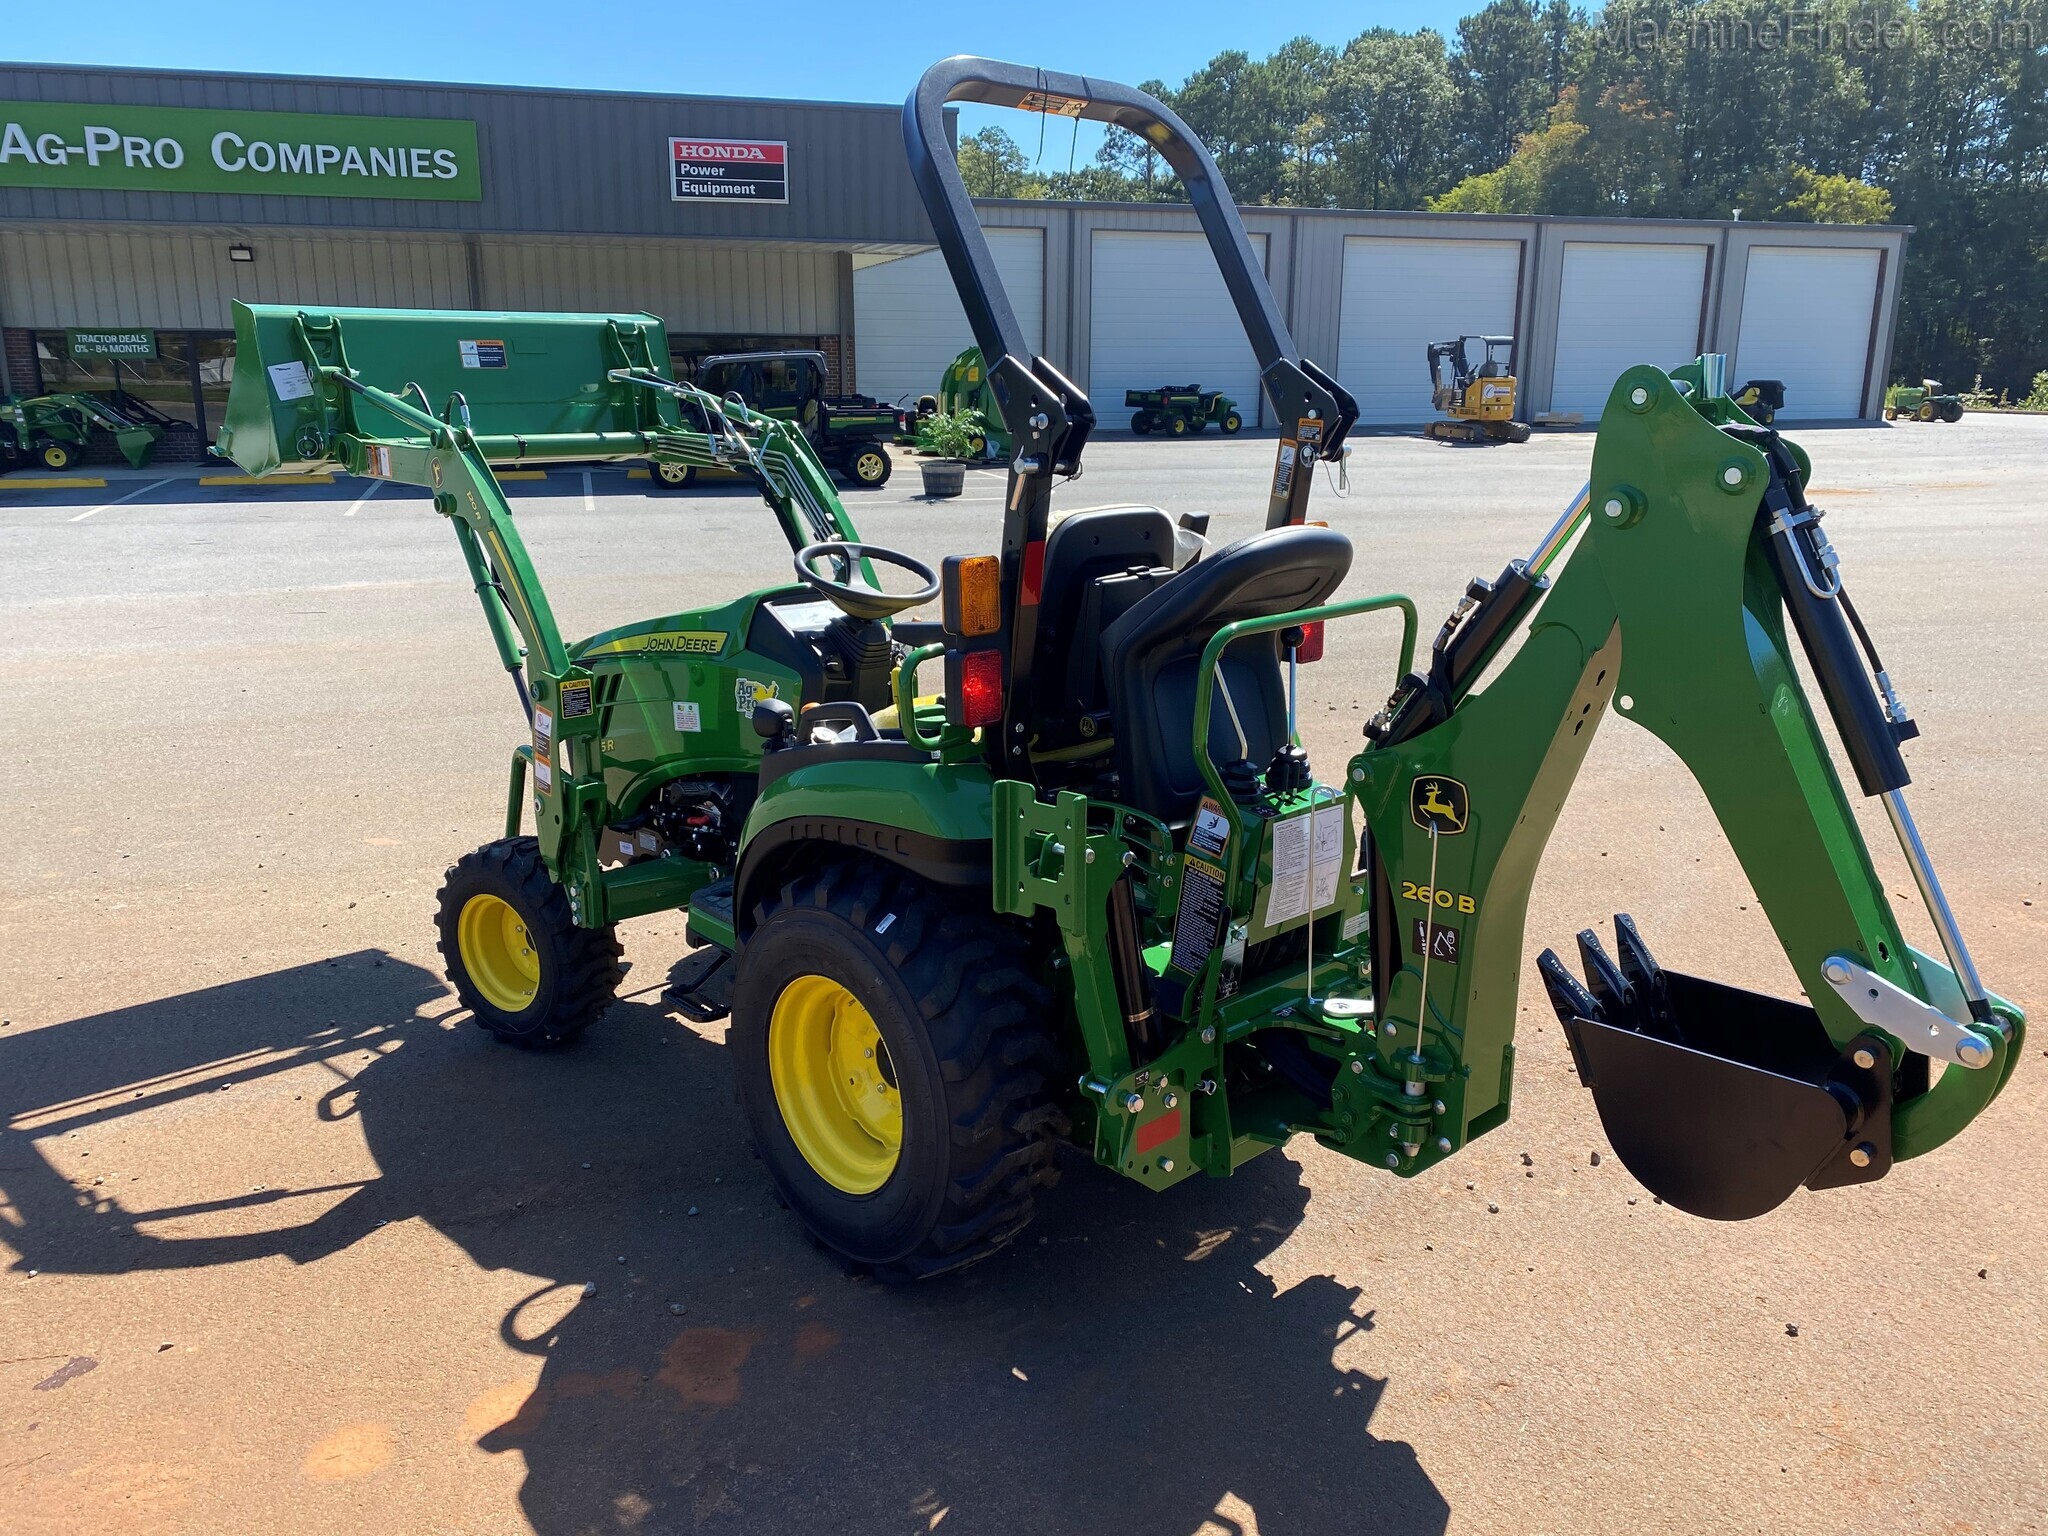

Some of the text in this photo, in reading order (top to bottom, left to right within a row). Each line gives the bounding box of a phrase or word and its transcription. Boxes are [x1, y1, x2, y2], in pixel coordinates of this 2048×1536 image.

[680, 145, 766, 159] HONDA
[680, 163, 725, 176] Power
[681, 180, 756, 195] Equipment
[75, 334, 147, 343] TRACTOR DEALS
[74, 344, 88, 353] 0%
[95, 344, 108, 353] 84
[642, 635, 718, 652] JOHN DEERE
[568, 680, 590, 689] CAUTION
[1195, 860, 1225, 881] CAUTION
[1402, 881, 1476, 914] 260 B
